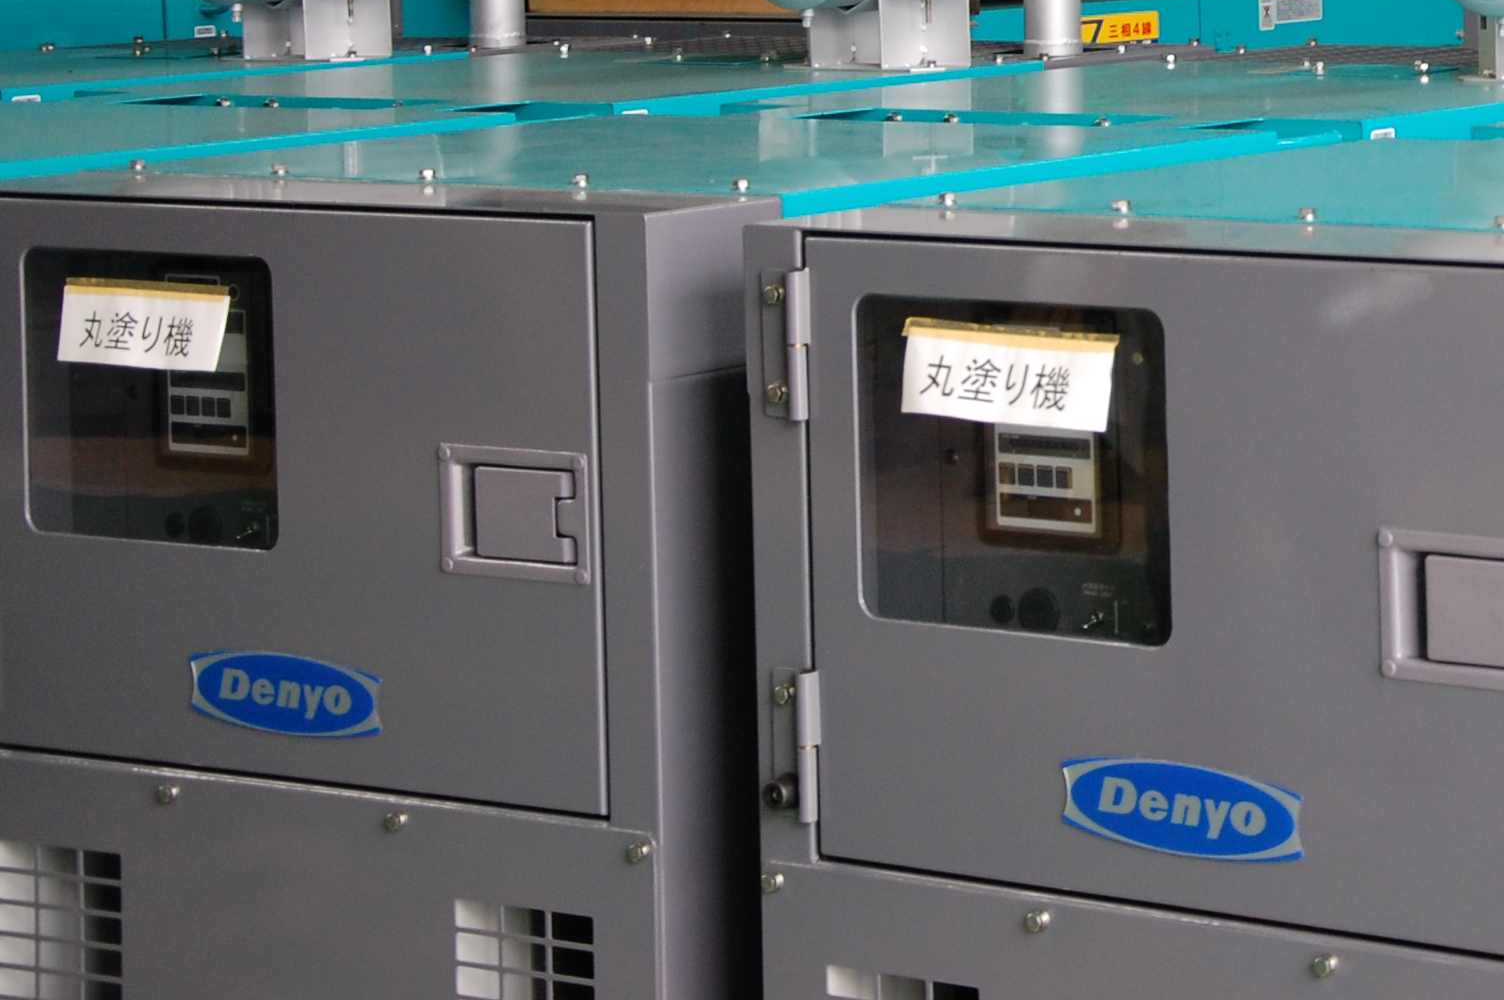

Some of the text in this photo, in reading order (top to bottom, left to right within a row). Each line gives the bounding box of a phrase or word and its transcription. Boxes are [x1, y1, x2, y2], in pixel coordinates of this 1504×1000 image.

[79, 311, 194, 358] 丸塗り機
[919, 354, 1071, 411] 丸塗り機
[218, 667, 353, 721] Denyo
[1097, 776, 1267, 840] Denyo
